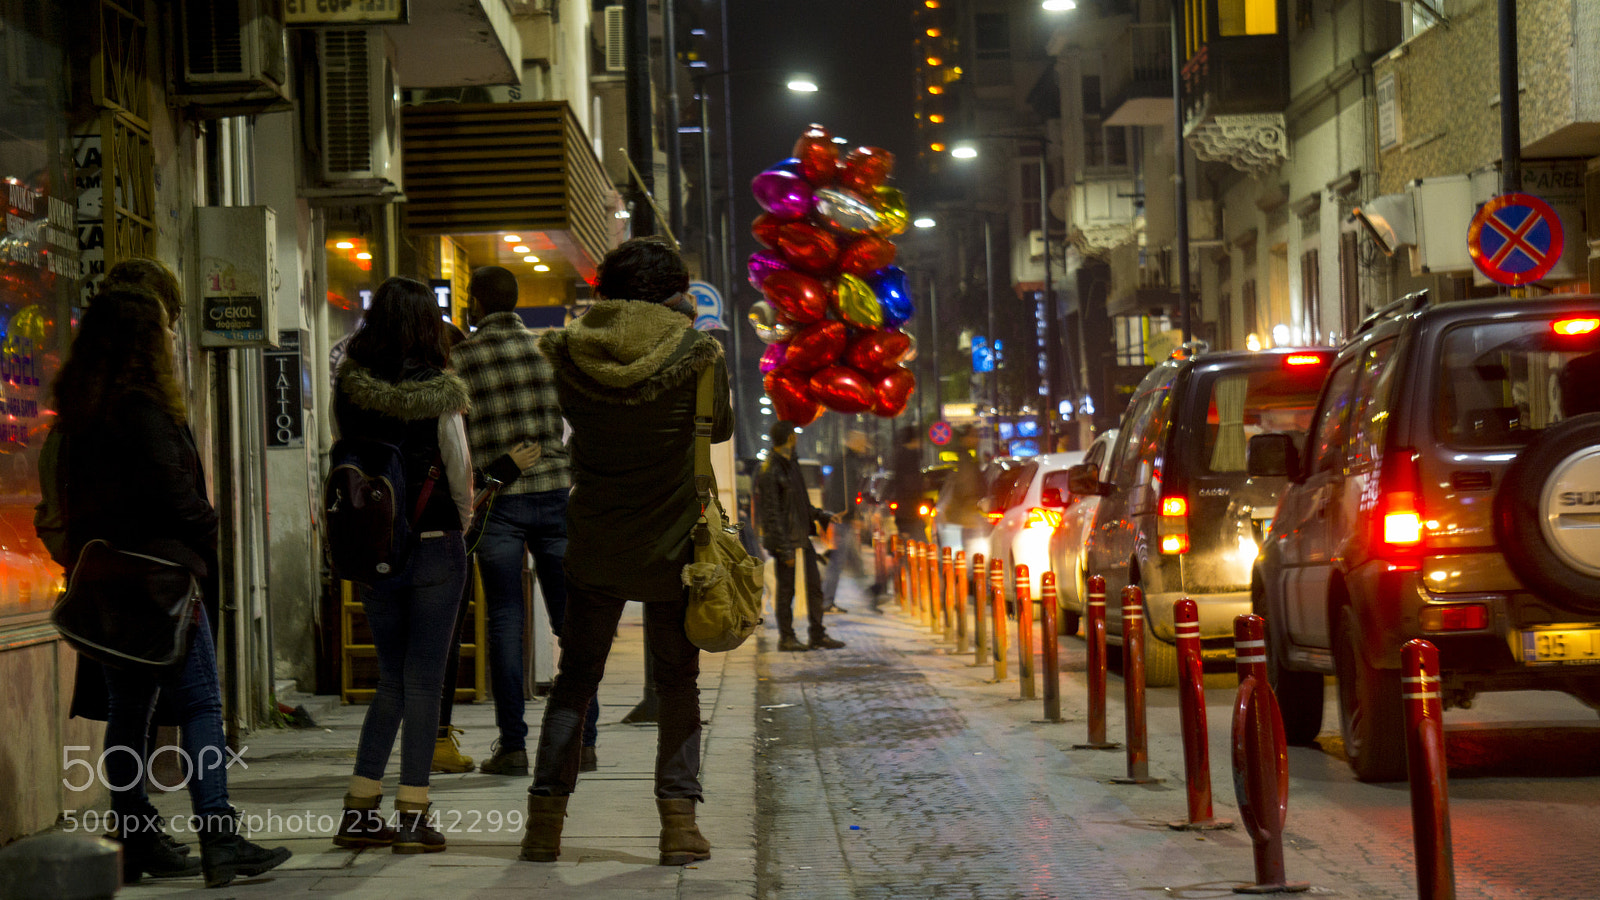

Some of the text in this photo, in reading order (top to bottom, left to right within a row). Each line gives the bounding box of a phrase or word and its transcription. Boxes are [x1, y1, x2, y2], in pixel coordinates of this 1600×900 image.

[1537, 171, 1584, 188] AREL
[224, 306, 257, 318] EKOL
[275, 357, 292, 443] TATTOO
[1559, 491, 1600, 506] SU
[1536, 634, 1565, 658] 35
